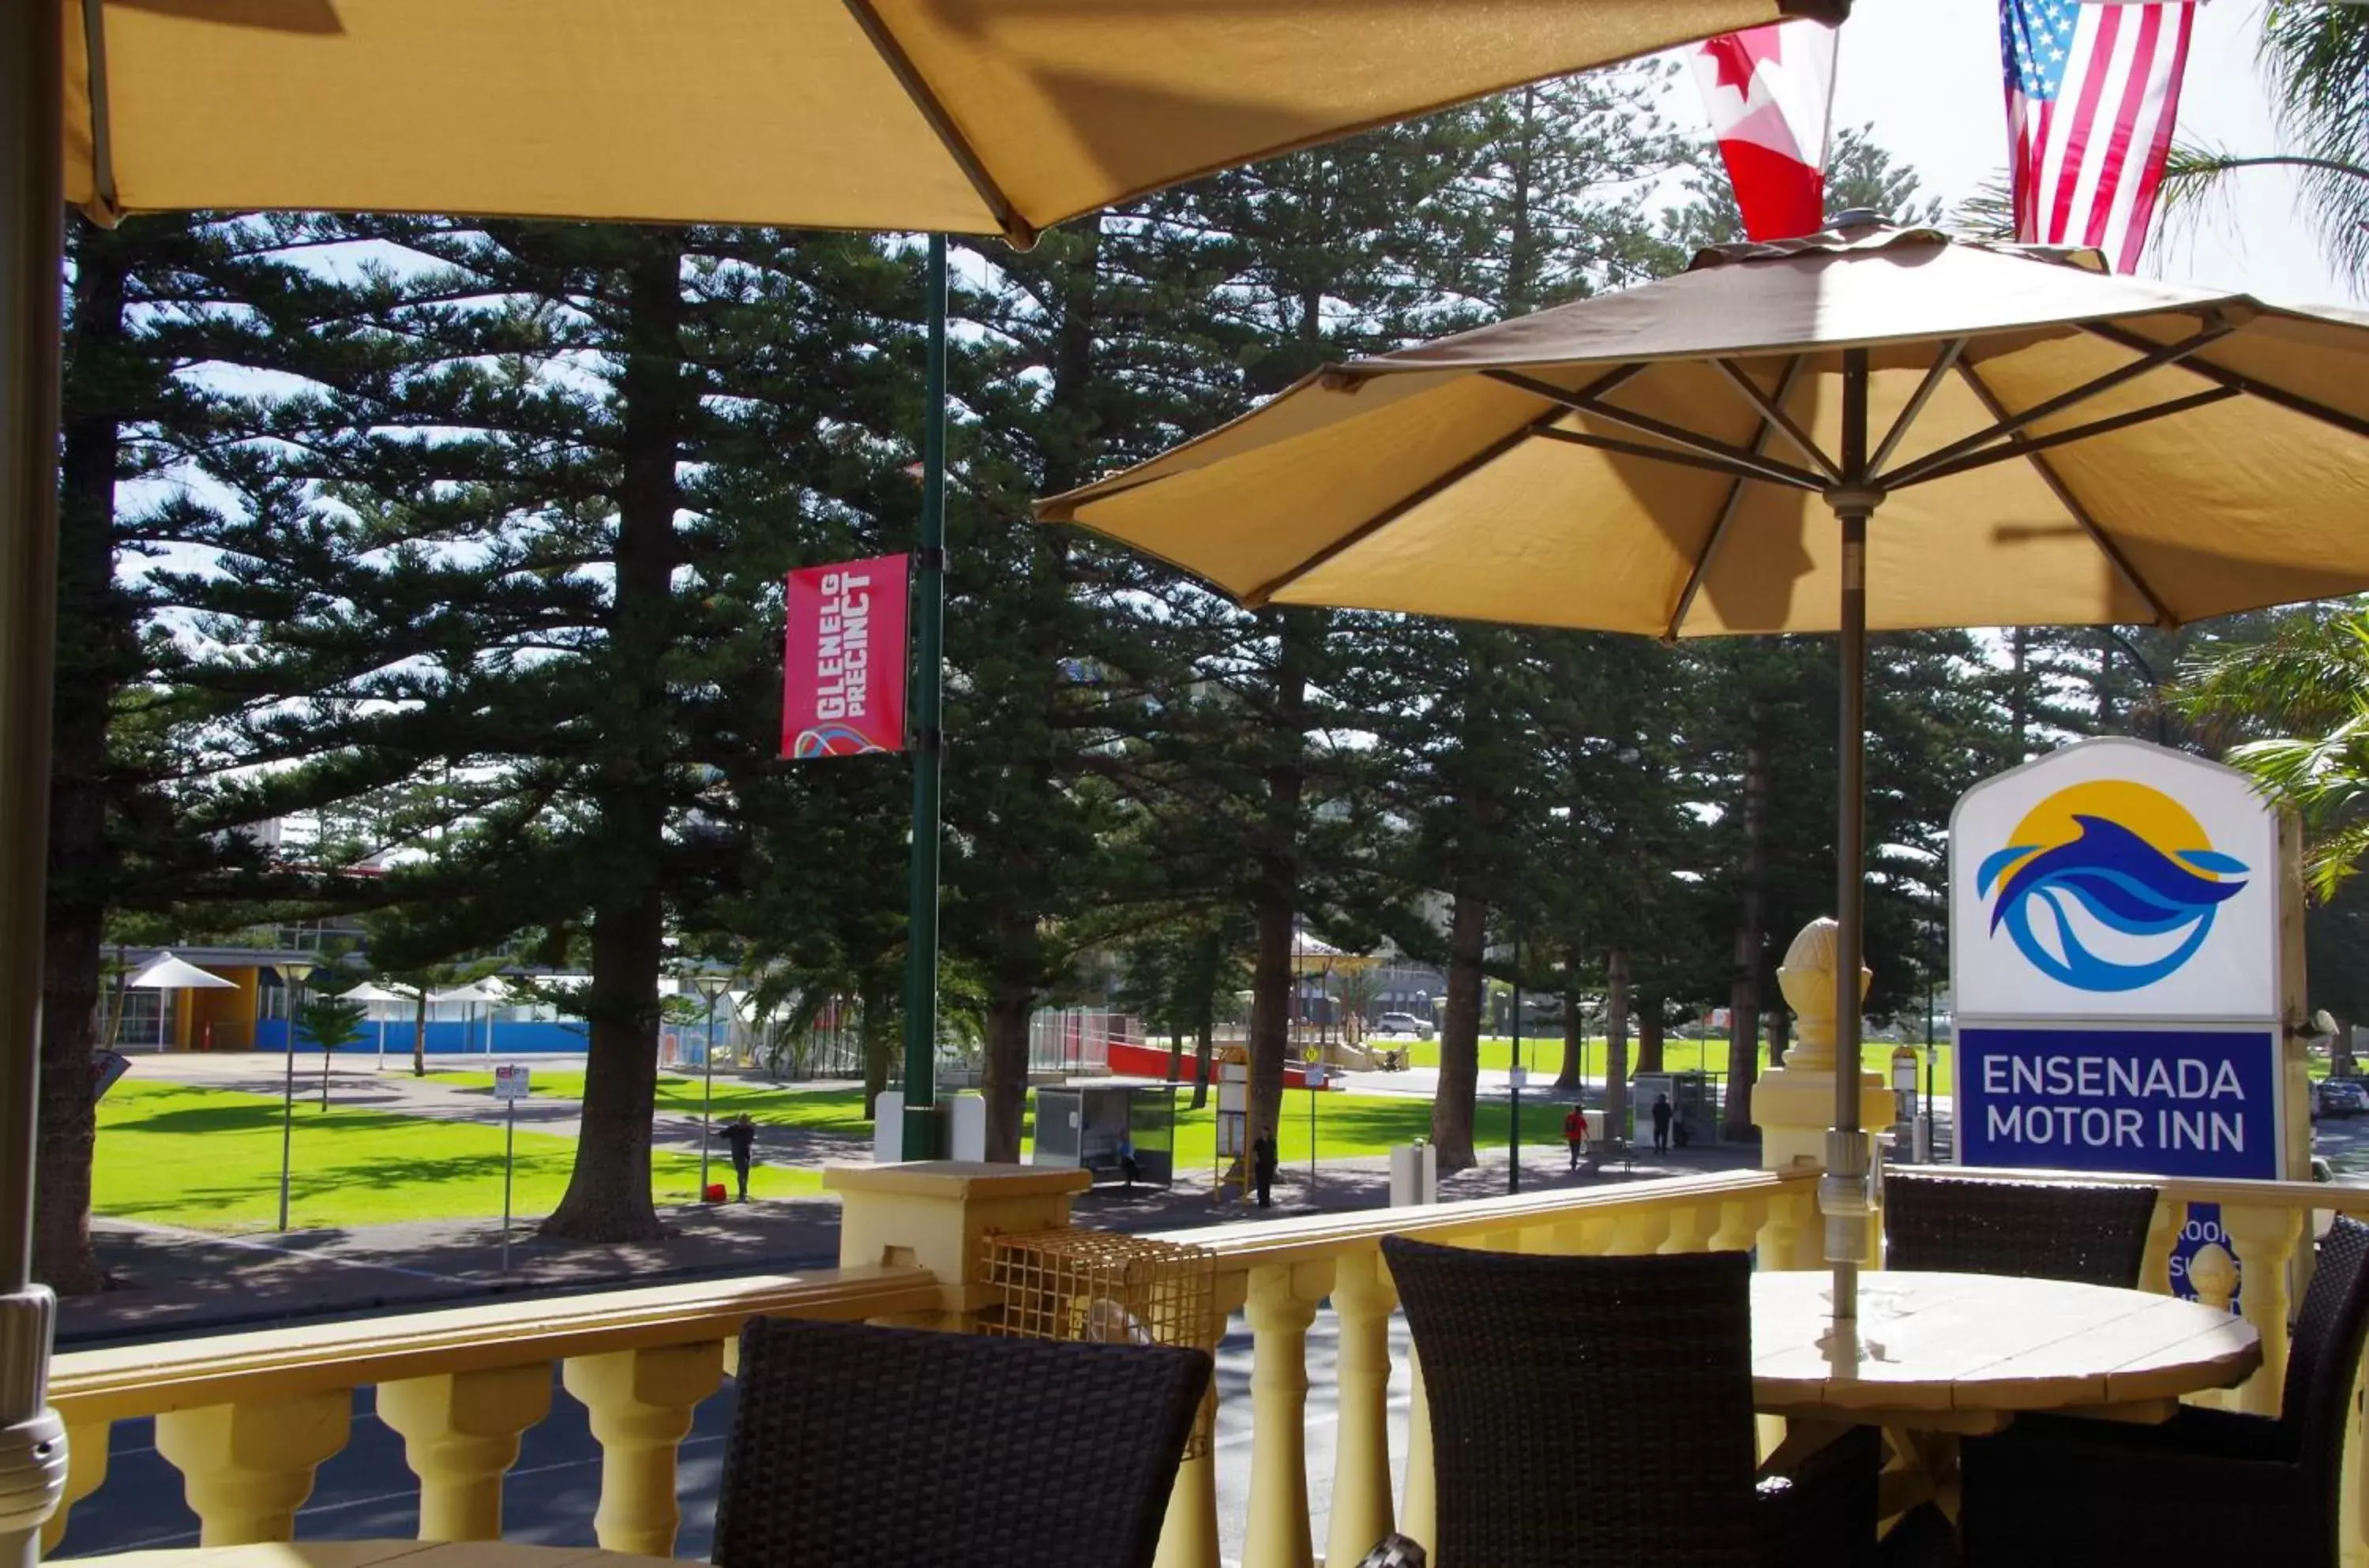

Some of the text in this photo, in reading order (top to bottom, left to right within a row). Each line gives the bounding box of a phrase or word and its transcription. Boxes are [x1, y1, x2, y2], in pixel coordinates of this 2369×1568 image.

[817, 573, 845, 719] GLENELG
[842, 572, 870, 717] PRECINCT
[1983, 1055, 2245, 1100] ENSENADA
[1987, 1105, 2243, 1152] MOTOR INN
